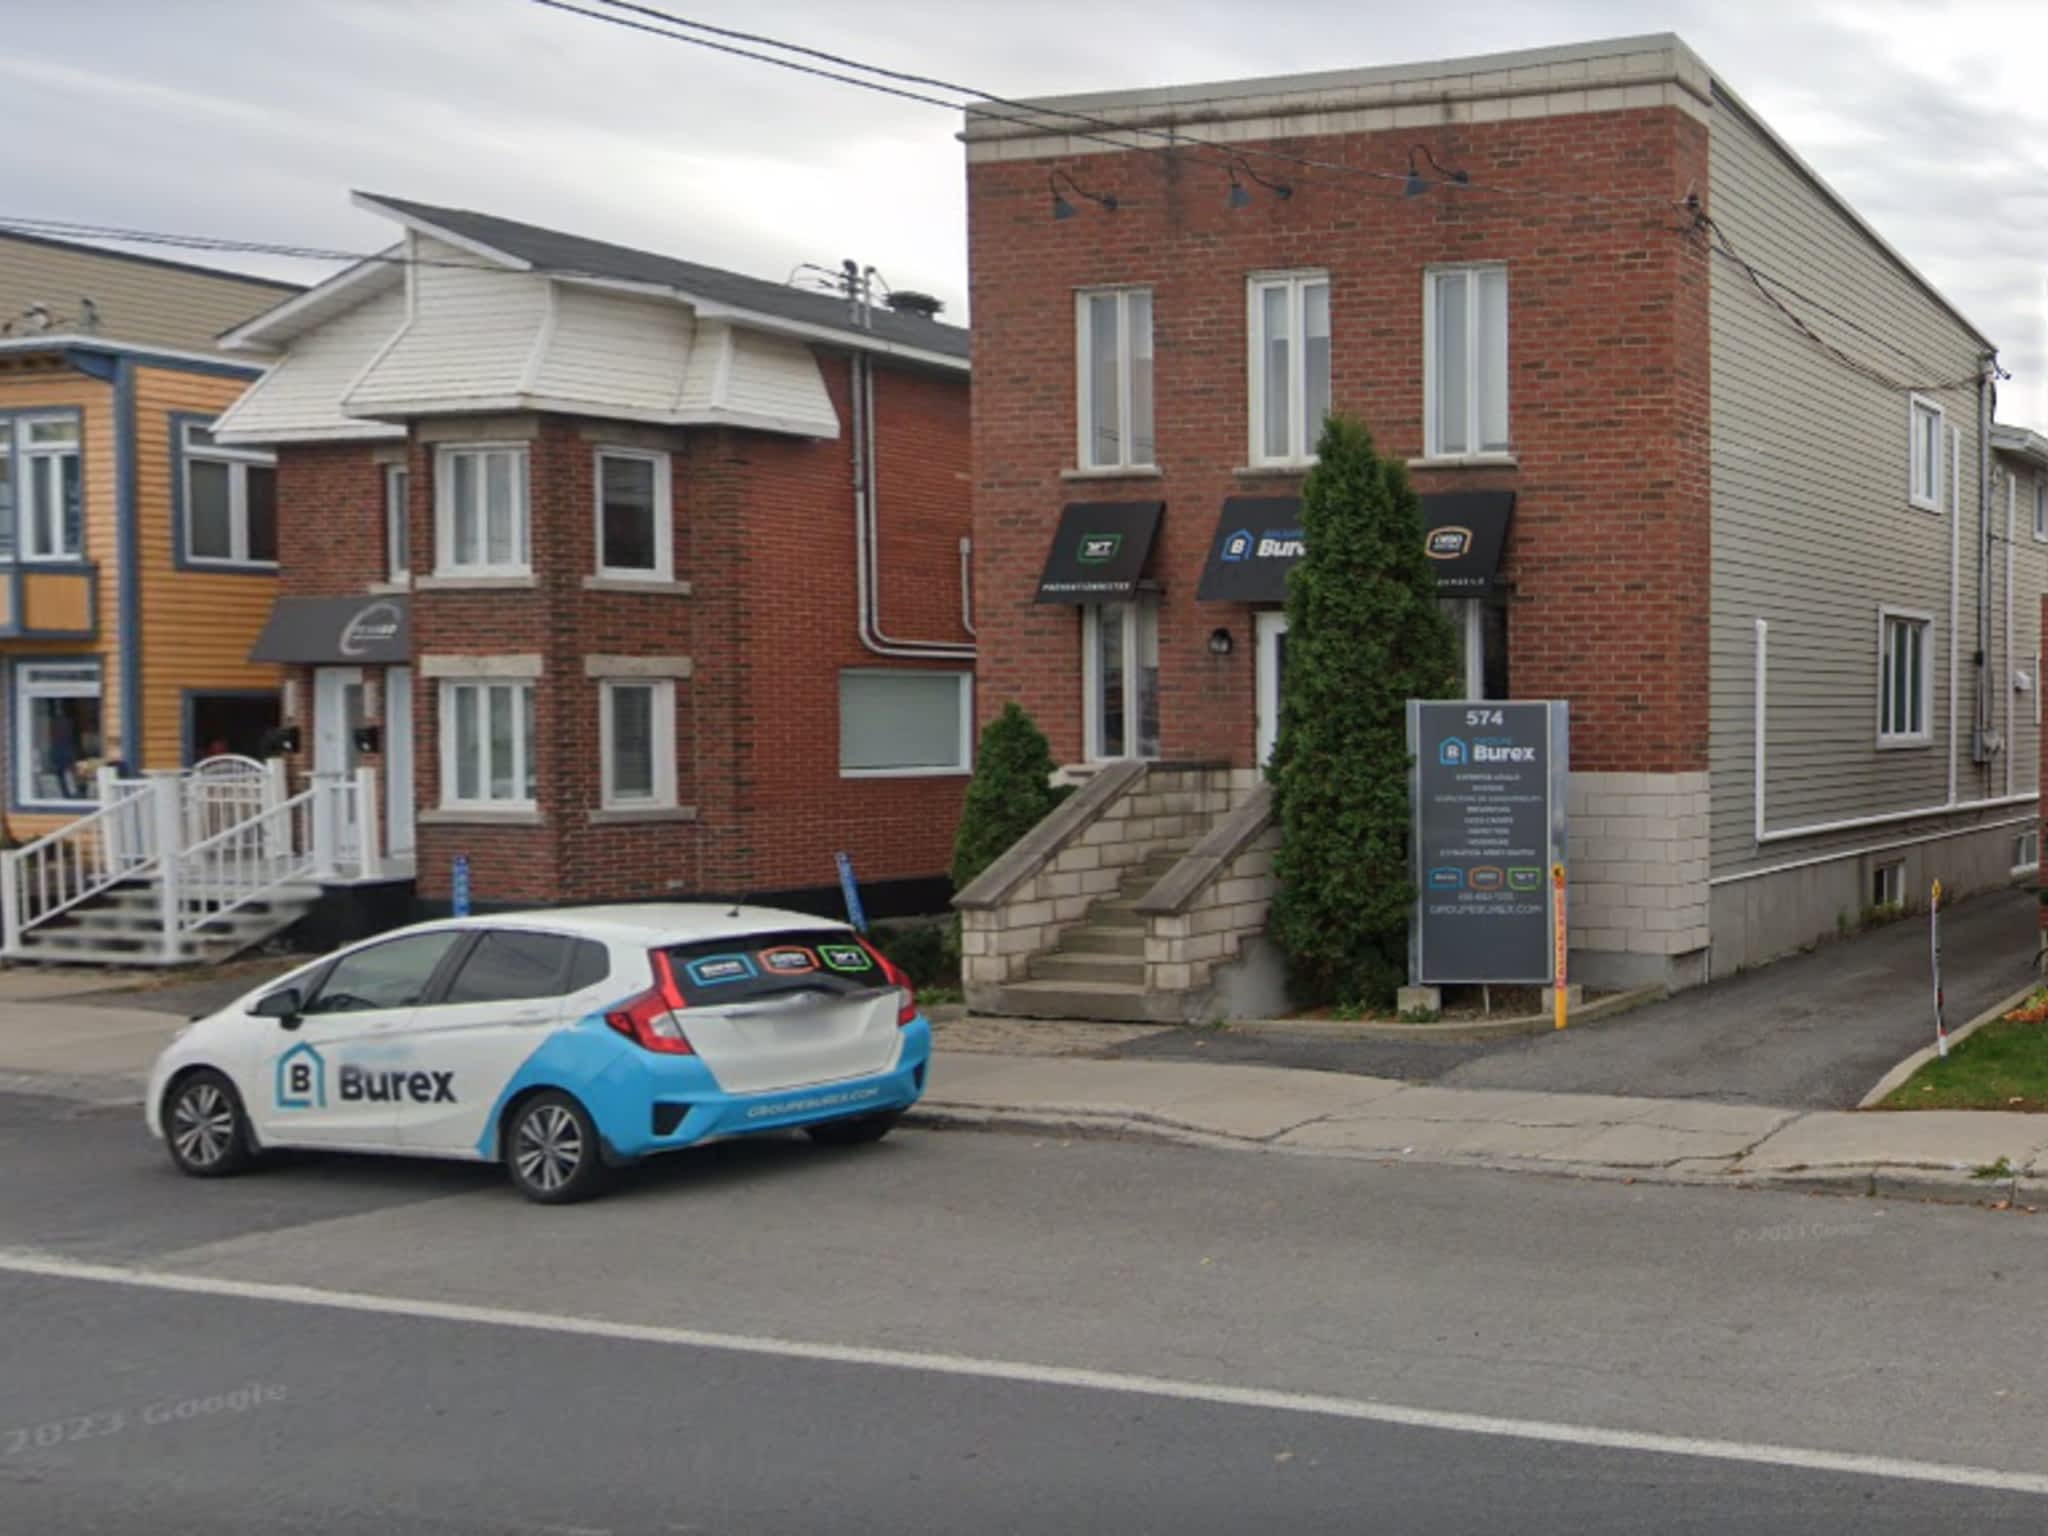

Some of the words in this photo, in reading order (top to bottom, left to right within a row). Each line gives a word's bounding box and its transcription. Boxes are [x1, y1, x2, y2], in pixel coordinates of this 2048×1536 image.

[1465, 709, 1504, 726] 574
[1472, 744, 1536, 762] Burex
[290, 1063, 311, 1093] B
[339, 1064, 458, 1104] Burex
